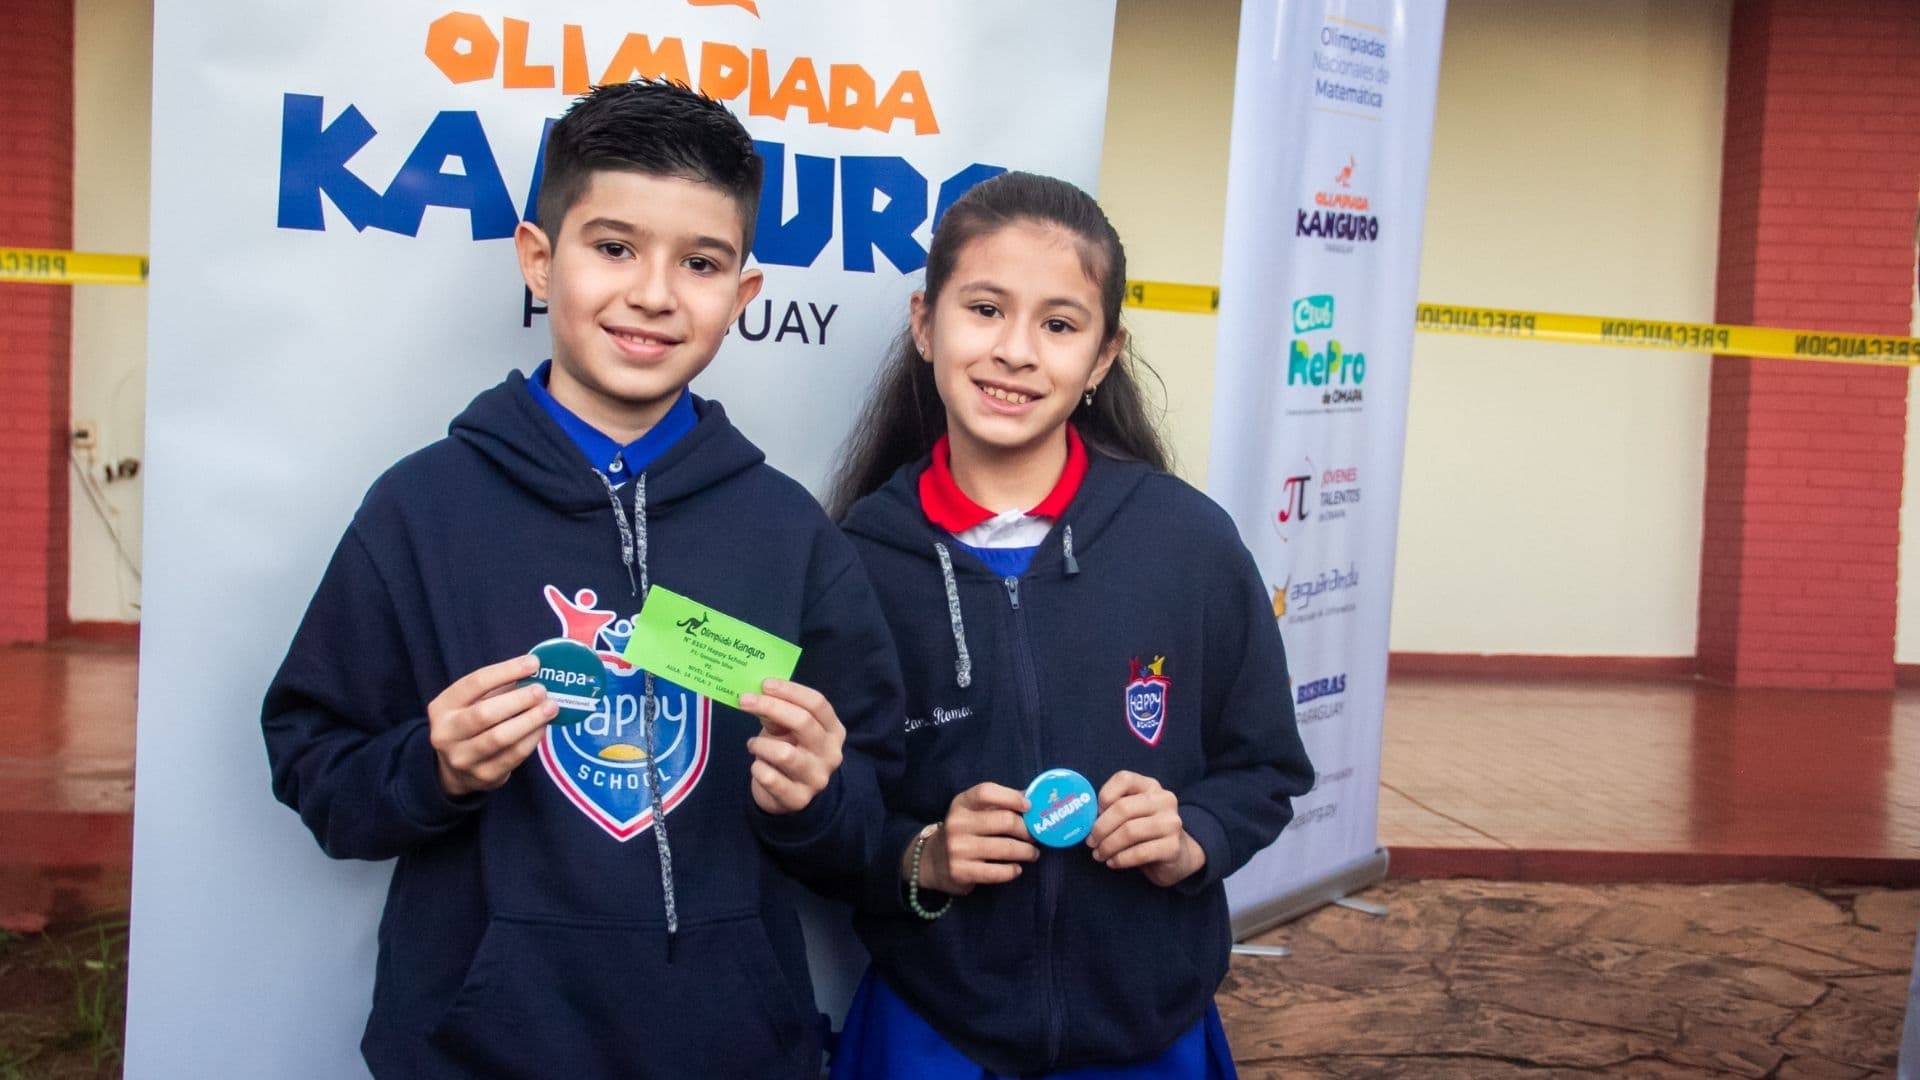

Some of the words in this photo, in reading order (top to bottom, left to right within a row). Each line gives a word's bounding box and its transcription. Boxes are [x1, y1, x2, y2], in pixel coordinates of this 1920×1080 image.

[1321, 26, 1386, 59] Olimpiadas
[425, 11, 940, 136] OLIMPIADA
[1296, 208, 1378, 242] KANGURO
[1287, 339, 1365, 386] RePro
[700, 627, 733, 647] Olimpiada
[733, 639, 766, 660] Kanguro
[728, 654, 748, 667] School
[1033, 792, 1091, 834] KANGURO
